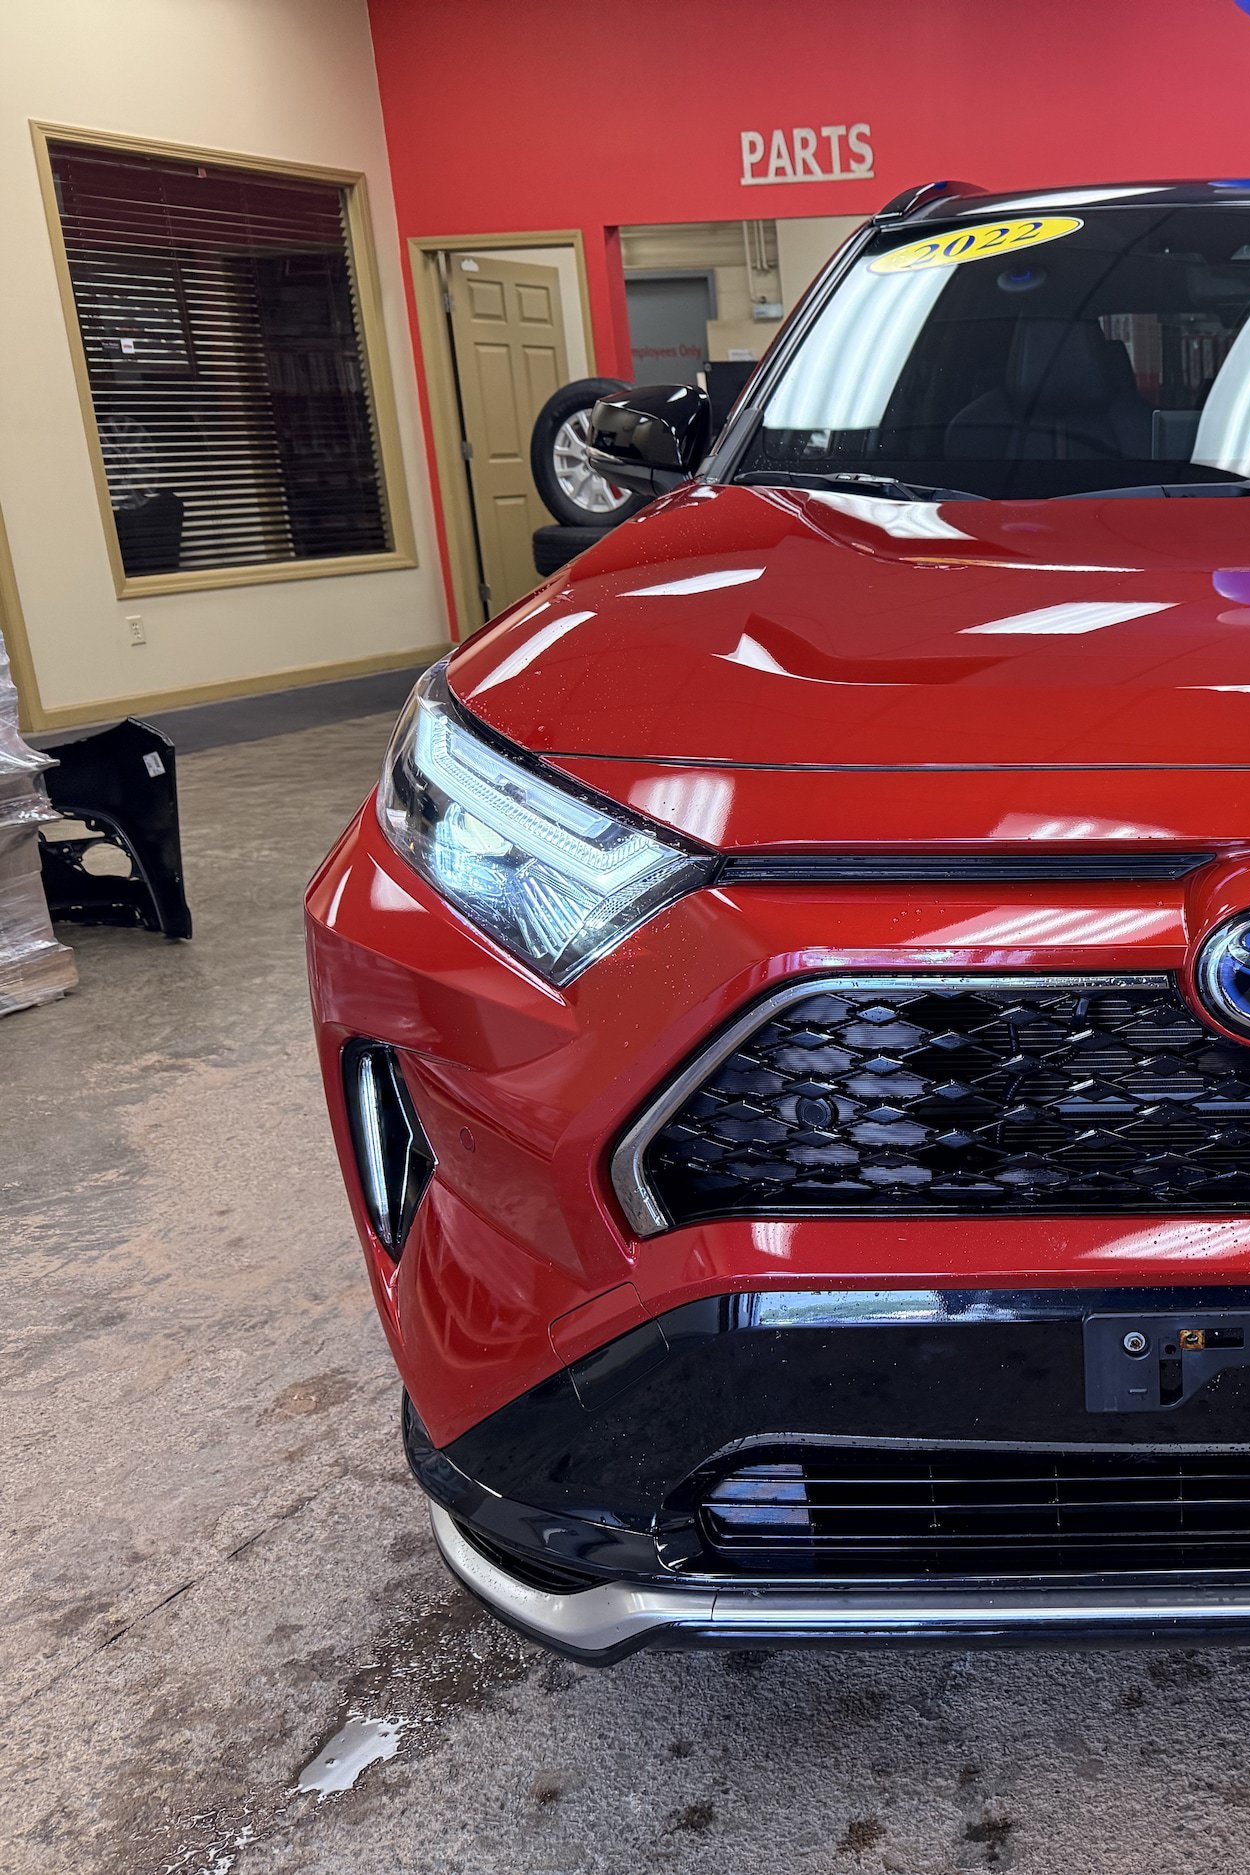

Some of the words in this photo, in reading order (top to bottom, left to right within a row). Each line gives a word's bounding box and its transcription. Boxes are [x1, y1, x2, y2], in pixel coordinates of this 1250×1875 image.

[741, 123, 874, 180] PARTS
[905, 222, 1044, 268] 2022
[632, 345, 677, 361] mployees
